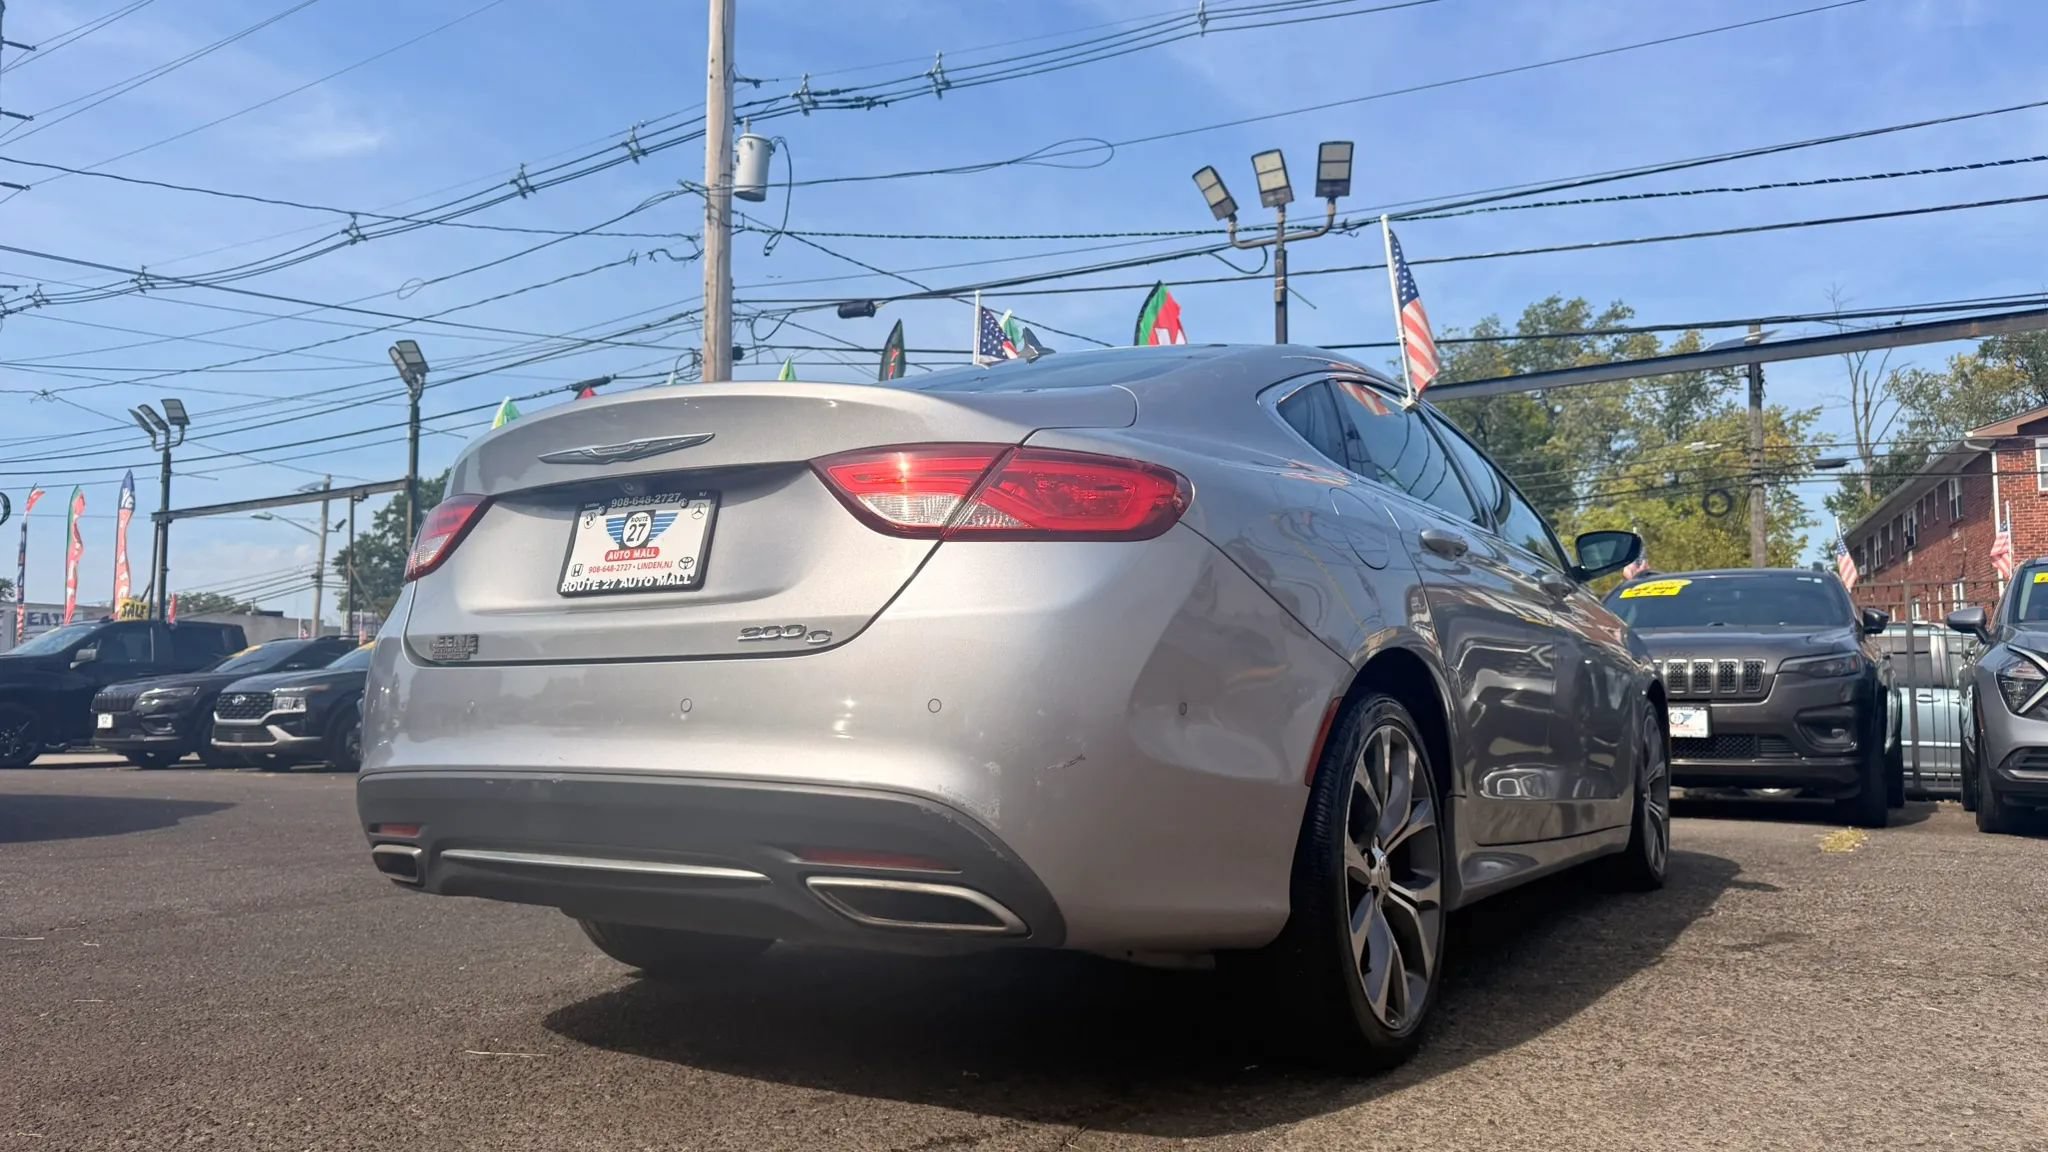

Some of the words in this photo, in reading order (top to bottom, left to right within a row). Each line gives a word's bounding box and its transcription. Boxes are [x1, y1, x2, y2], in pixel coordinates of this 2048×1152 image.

[611, 492, 681, 508] 908-648-2727
[630, 515, 649, 523] ROUTE
[626, 522, 647, 542] 27
[607, 550, 631, 560] AUTO
[633, 547, 657, 558] MALL
[588, 563, 632, 574] 908-648-2727
[560, 580, 601, 593] ROUTE
[602, 579, 617, 589] 27
[619, 576, 654, 588] AUTO
[656, 574, 692, 586] MALL
[737, 624, 807, 642] 200
